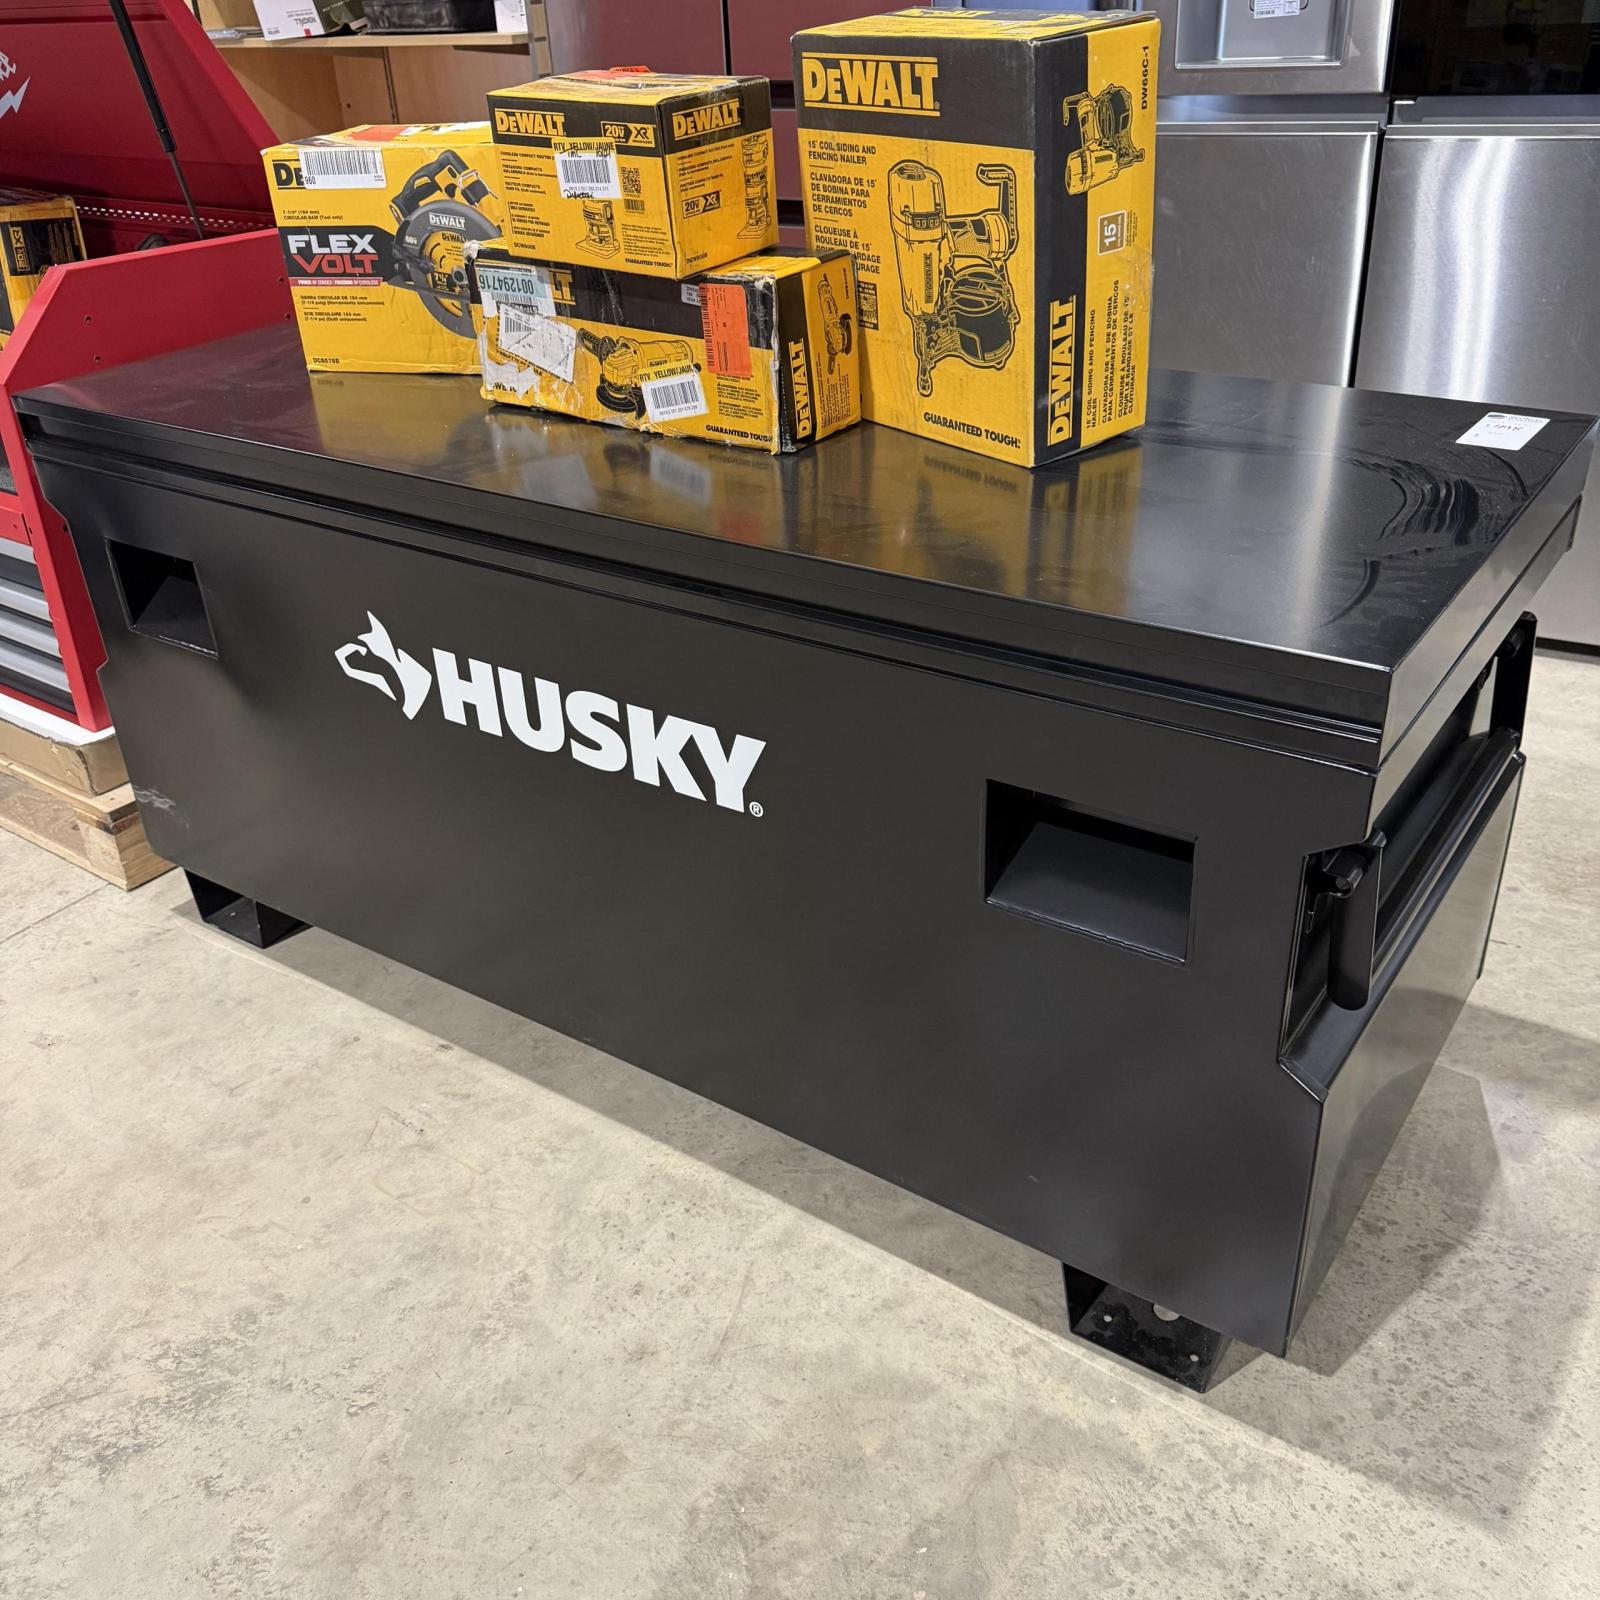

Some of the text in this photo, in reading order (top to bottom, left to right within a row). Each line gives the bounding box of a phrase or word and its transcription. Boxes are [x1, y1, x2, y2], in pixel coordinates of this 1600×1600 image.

[1141, 45, 1149, 110] DW66C-1
[634, 126, 650, 140] XR
[554, 143, 565, 151] RTV
[819, 141, 835, 150] COIL
[836, 143, 859, 153] SIDING
[861, 145, 877, 154] AND
[808, 151, 867, 165] FENCING NAILER
[810, 172, 852, 185] CLAVADORA
[854, 177, 864, 186] DE
[811, 183, 870, 198] DE BOBINA PARA
[812, 193, 867, 209] CERRAMIENTOS
[812, 203, 853, 217] DE CERCOS
[814, 224, 851, 238] CLOUEUSE
[287, 234, 377, 254] FLEX
[815, 235, 848, 248] ROULEAU
[850, 241, 859, 250] DE
[292, 254, 378, 273] VOLT
[479, 274, 534, 295] 001294716
[1112, 318, 1117, 330] DE
[1106, 331, 1111, 344] DE
[1104, 361, 1109, 372] DE
[640, 373, 651, 382] RTV
[923, 411, 983, 438] GUARANTEED
[706, 425, 749, 439] GUARANTEED
[432, 647, 766, 814] HUSKY
